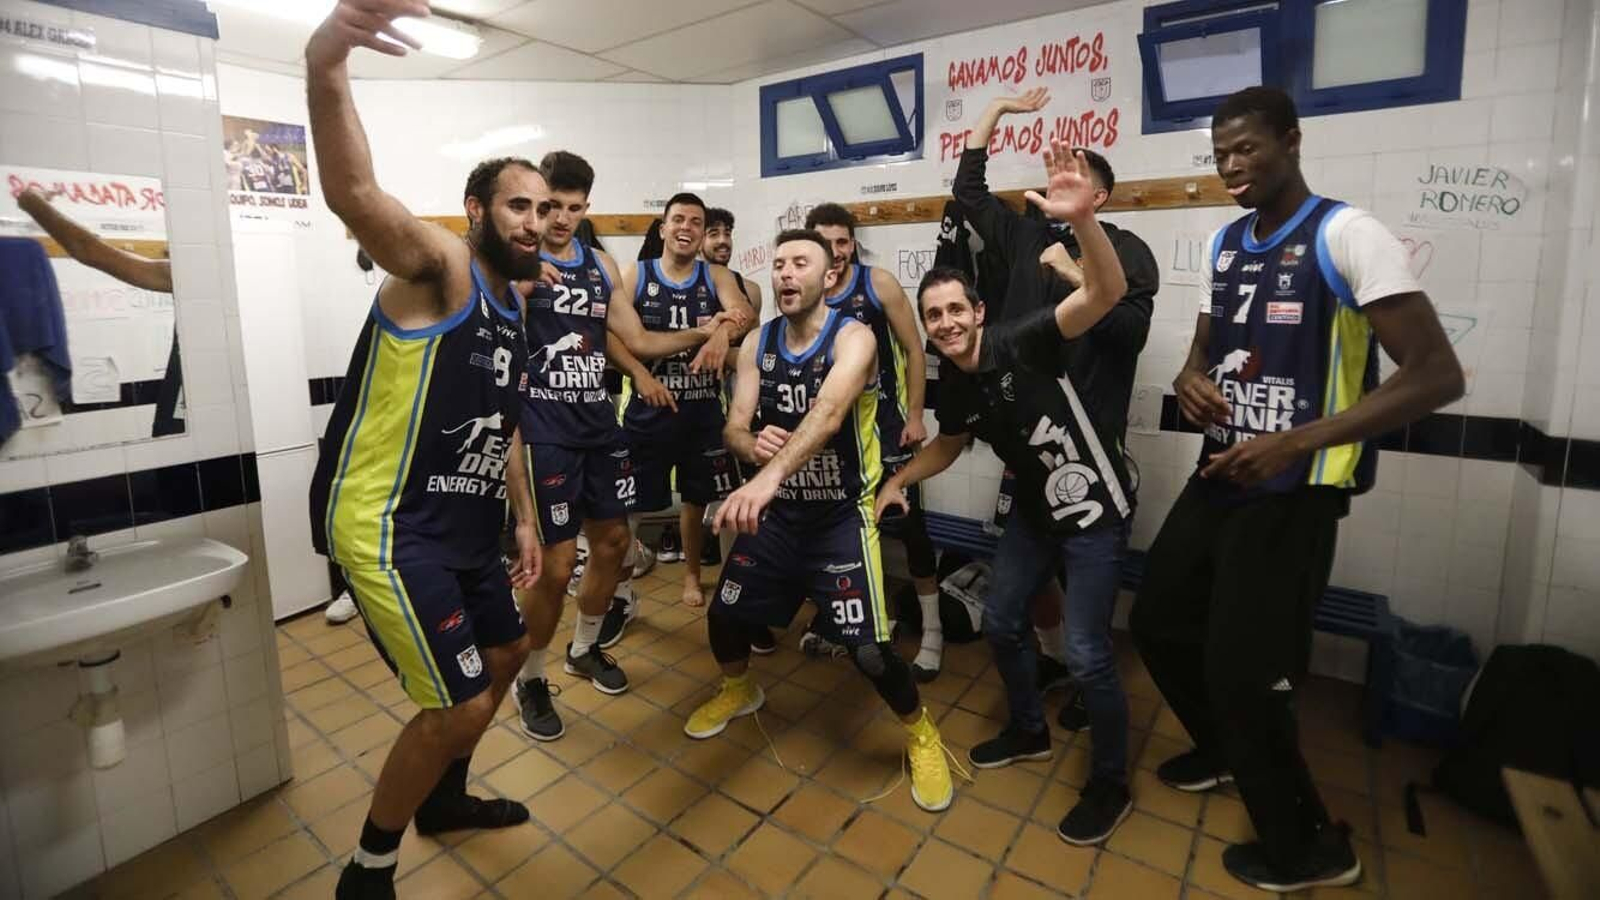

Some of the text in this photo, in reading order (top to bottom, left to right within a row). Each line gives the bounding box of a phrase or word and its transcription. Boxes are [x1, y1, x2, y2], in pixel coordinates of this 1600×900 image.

[948, 32, 1108, 91] GANAMOS JUNTOS,
[1417, 164, 1510, 189] JAVIER
[1419, 189, 1521, 215] ROMERO
[552, 284, 589, 316] 22
[1233, 284, 1258, 324] 7
[668, 305, 690, 329] 11
[1263, 376, 1294, 386] VITALIS
[530, 387, 581, 403] ENERGY
[776, 384, 807, 414] 30
[1222, 379, 1296, 411] ENER
[426, 475, 494, 497] ENERGY
[615, 475, 636, 499] 22
[713, 473, 732, 492] 11
[804, 488, 847, 500] DRINK
[831, 598, 865, 625] 30
